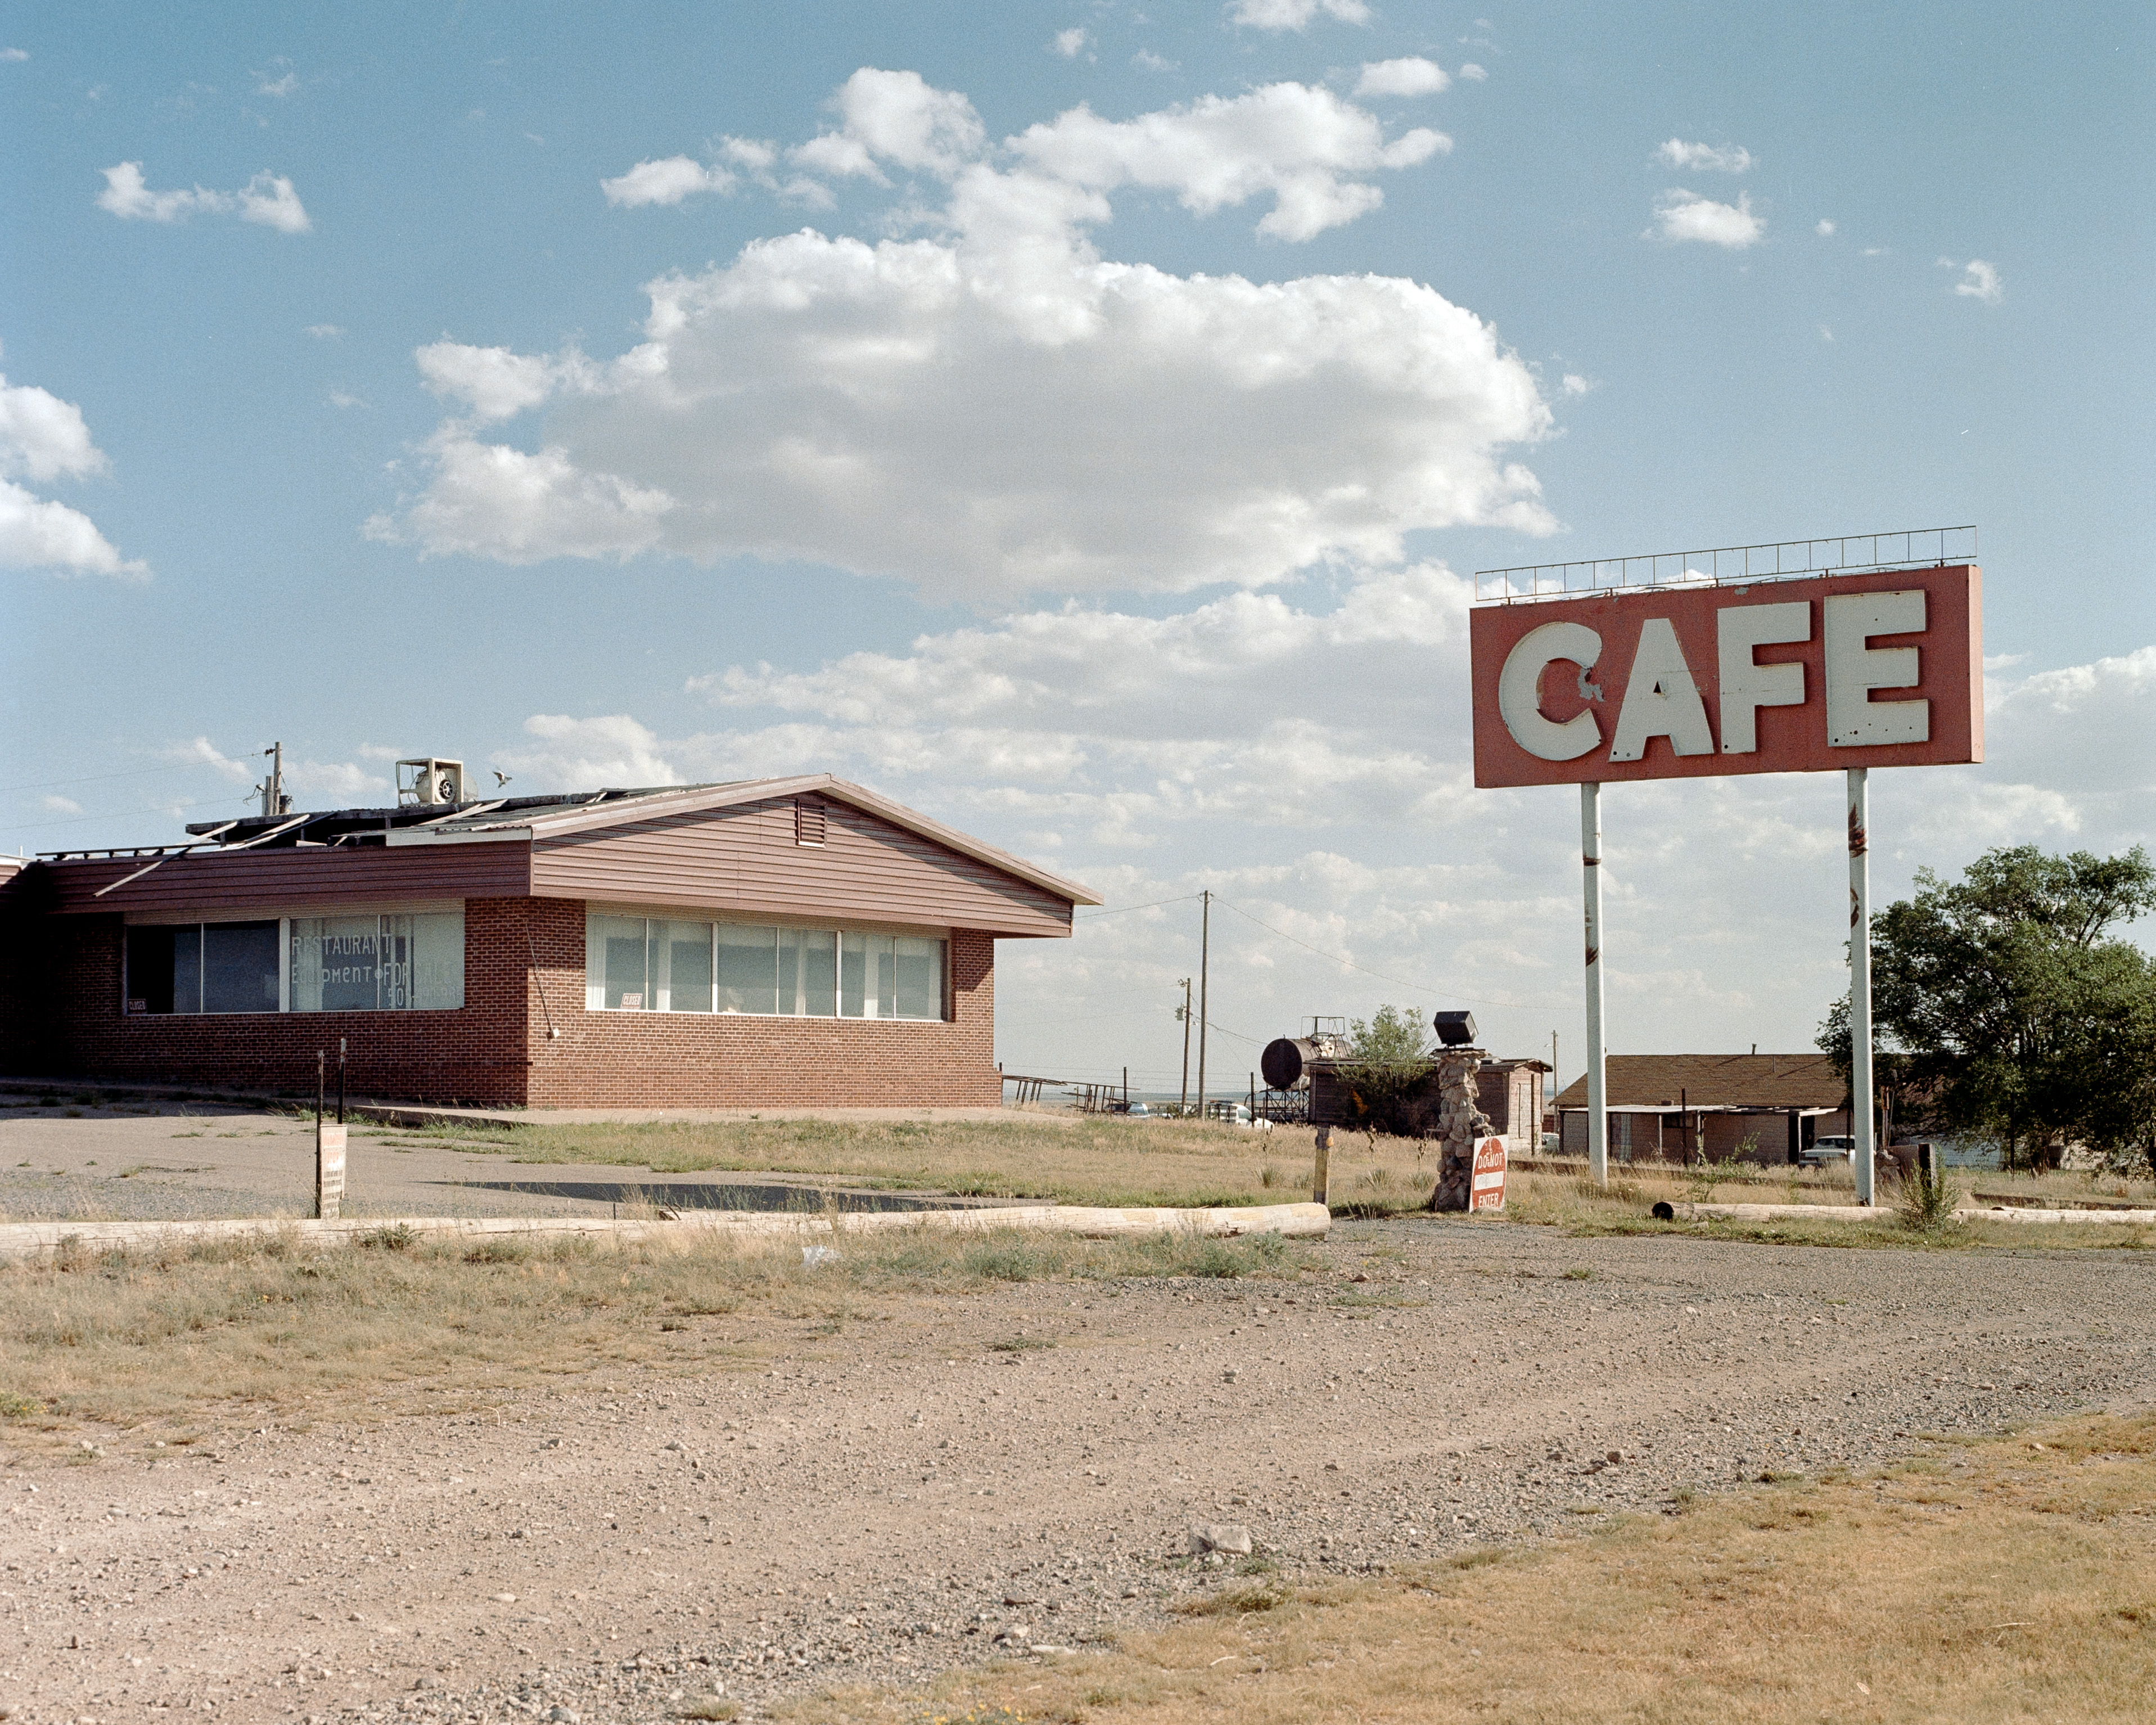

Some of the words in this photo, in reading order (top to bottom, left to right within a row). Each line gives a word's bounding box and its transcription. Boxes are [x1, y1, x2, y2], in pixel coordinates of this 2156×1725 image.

[1498, 589, 1929, 763] CAFE
[623, 995, 641, 1005] CLOSED
[1478, 1155, 1487, 1169] DO
[1490, 1152, 1503, 1167] NOT
[1478, 1192, 1499, 1208] ENTER
